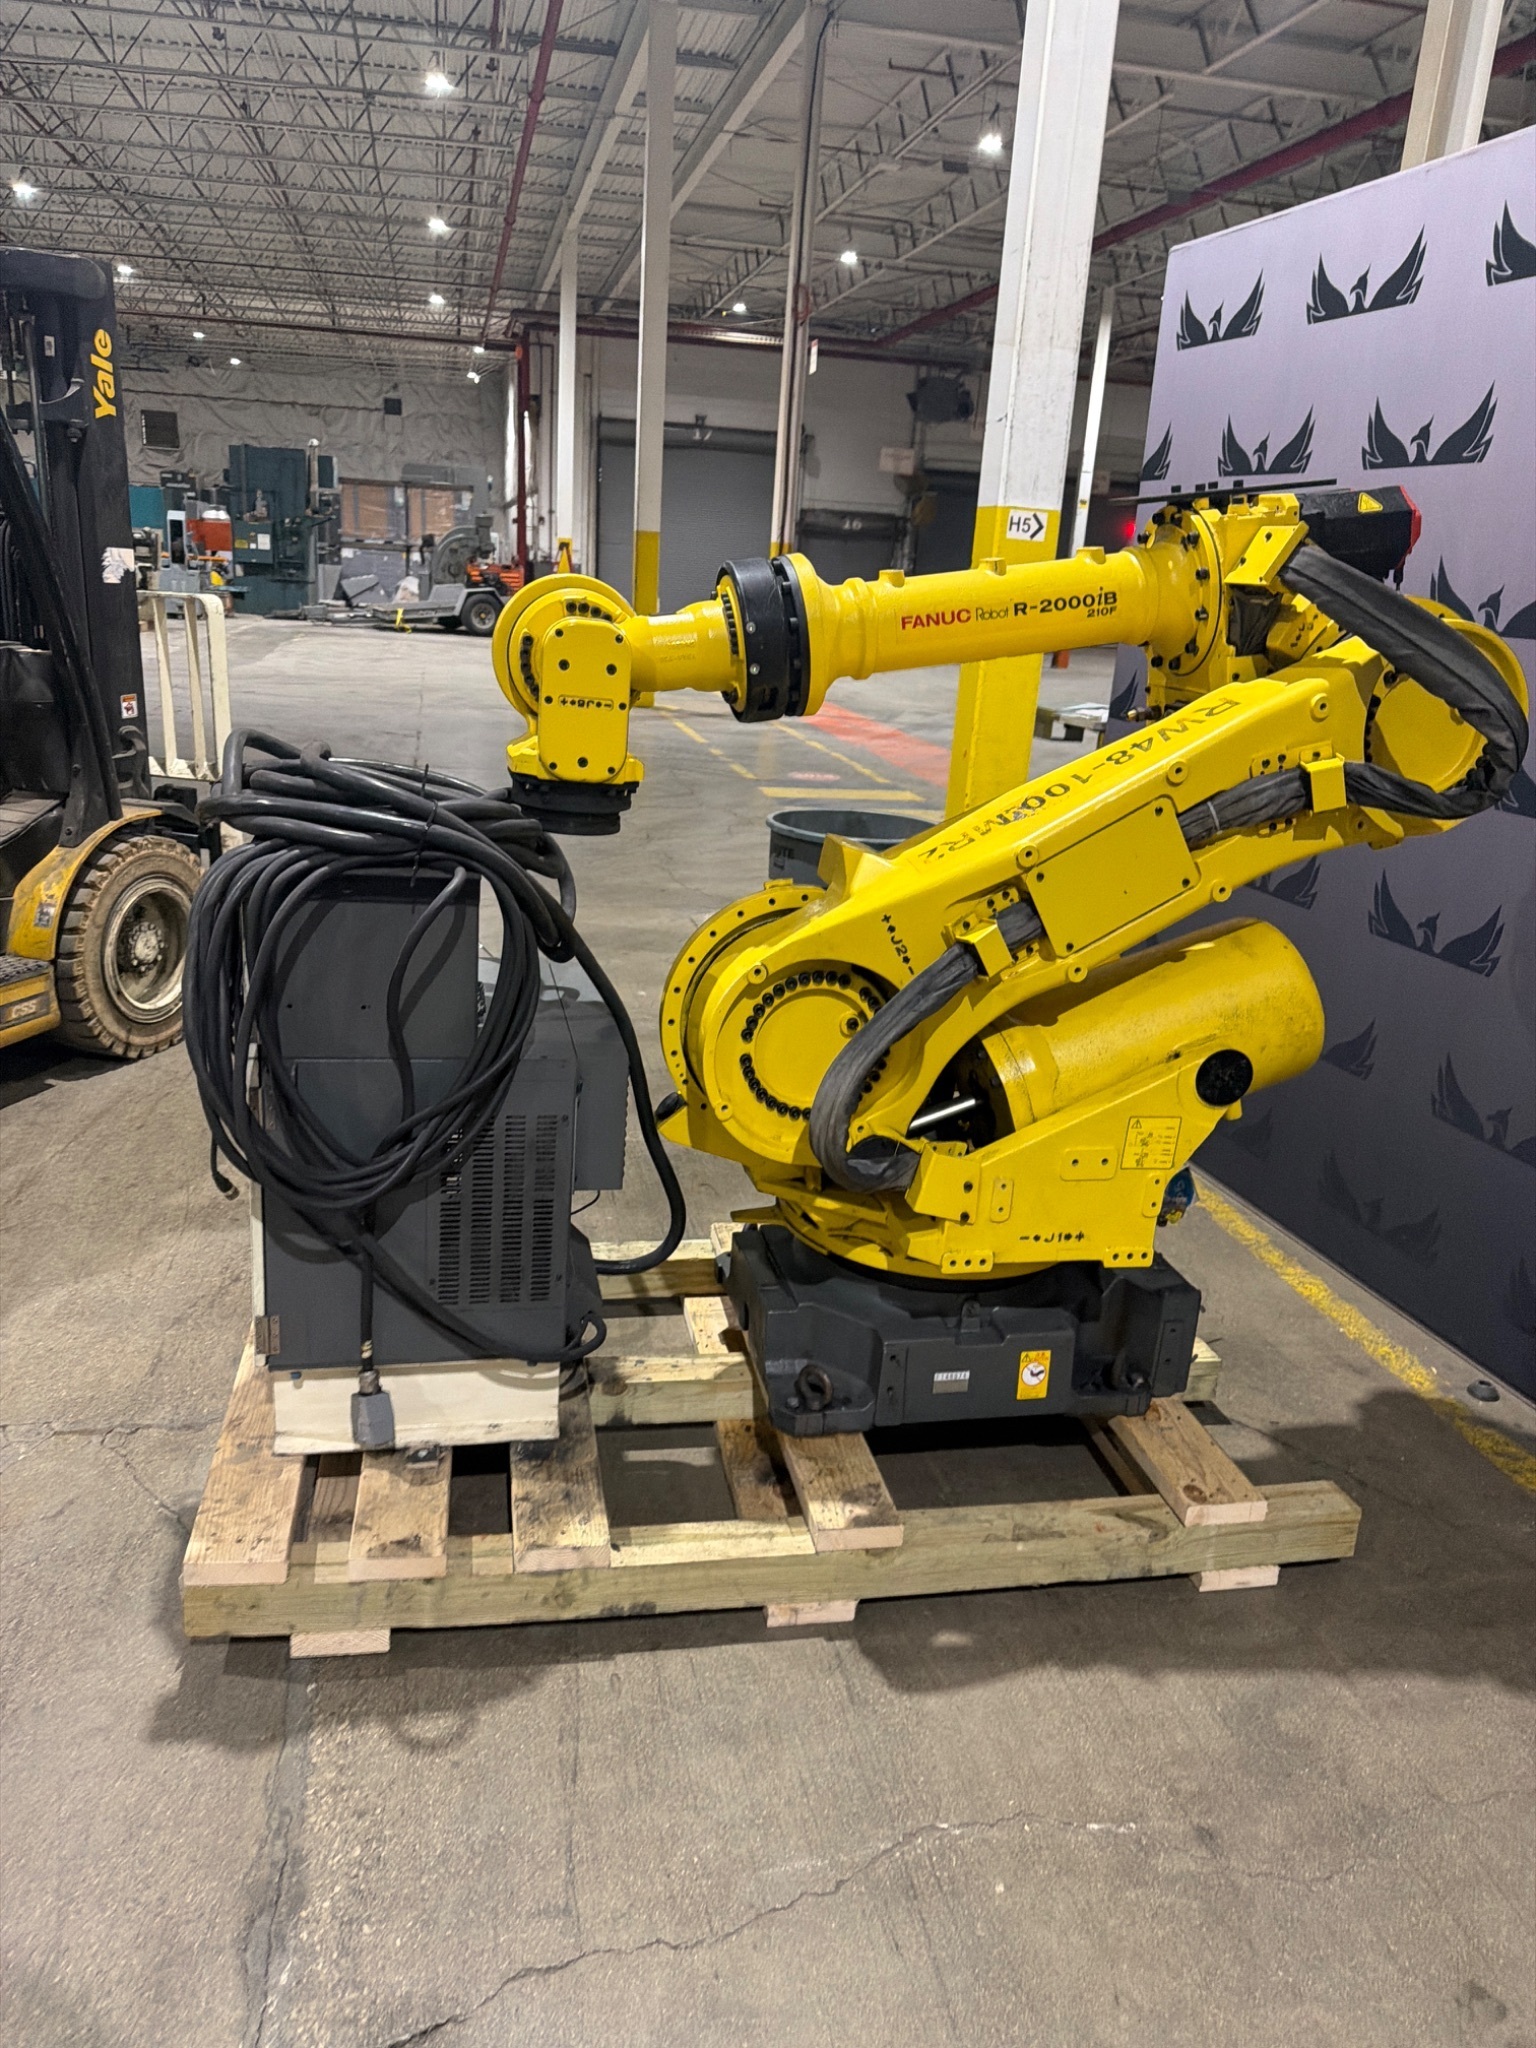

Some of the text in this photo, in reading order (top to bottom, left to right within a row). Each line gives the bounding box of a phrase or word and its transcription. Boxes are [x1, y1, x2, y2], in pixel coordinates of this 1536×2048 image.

[91, 328, 116, 419] Yale
[1008, 515, 1032, 534] H5
[901, 586, 1118, 631] FANUC Robot R-2000iB
[1086, 605, 1118, 618] 210F
